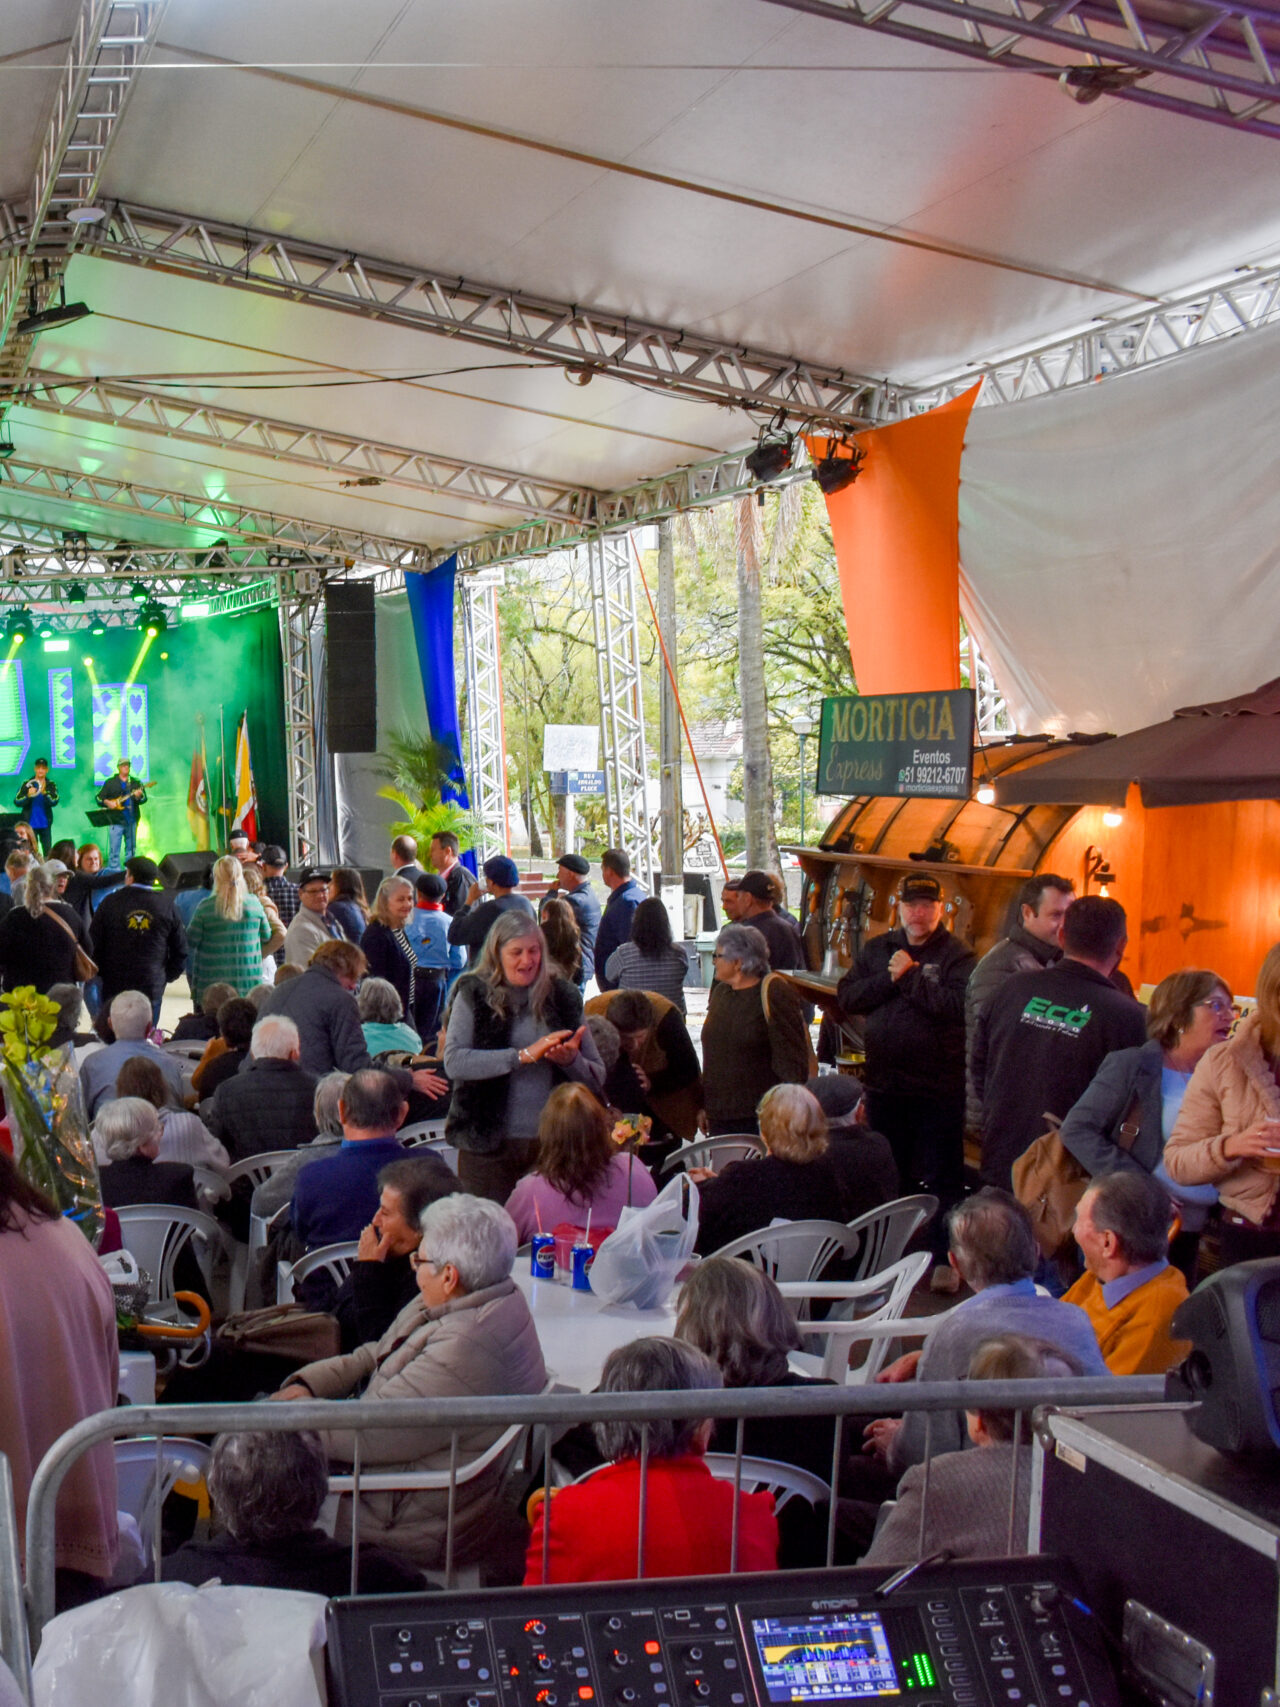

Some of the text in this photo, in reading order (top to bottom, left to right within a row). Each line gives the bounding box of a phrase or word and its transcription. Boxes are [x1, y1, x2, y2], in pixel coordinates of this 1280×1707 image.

[830, 696, 956, 742] MORTICIA
[825, 743, 884, 791] Express
[912, 750, 951, 765] Eventos
[904, 767, 967, 784] 51 99212-6707
[1023, 996, 1092, 1029] ECO
